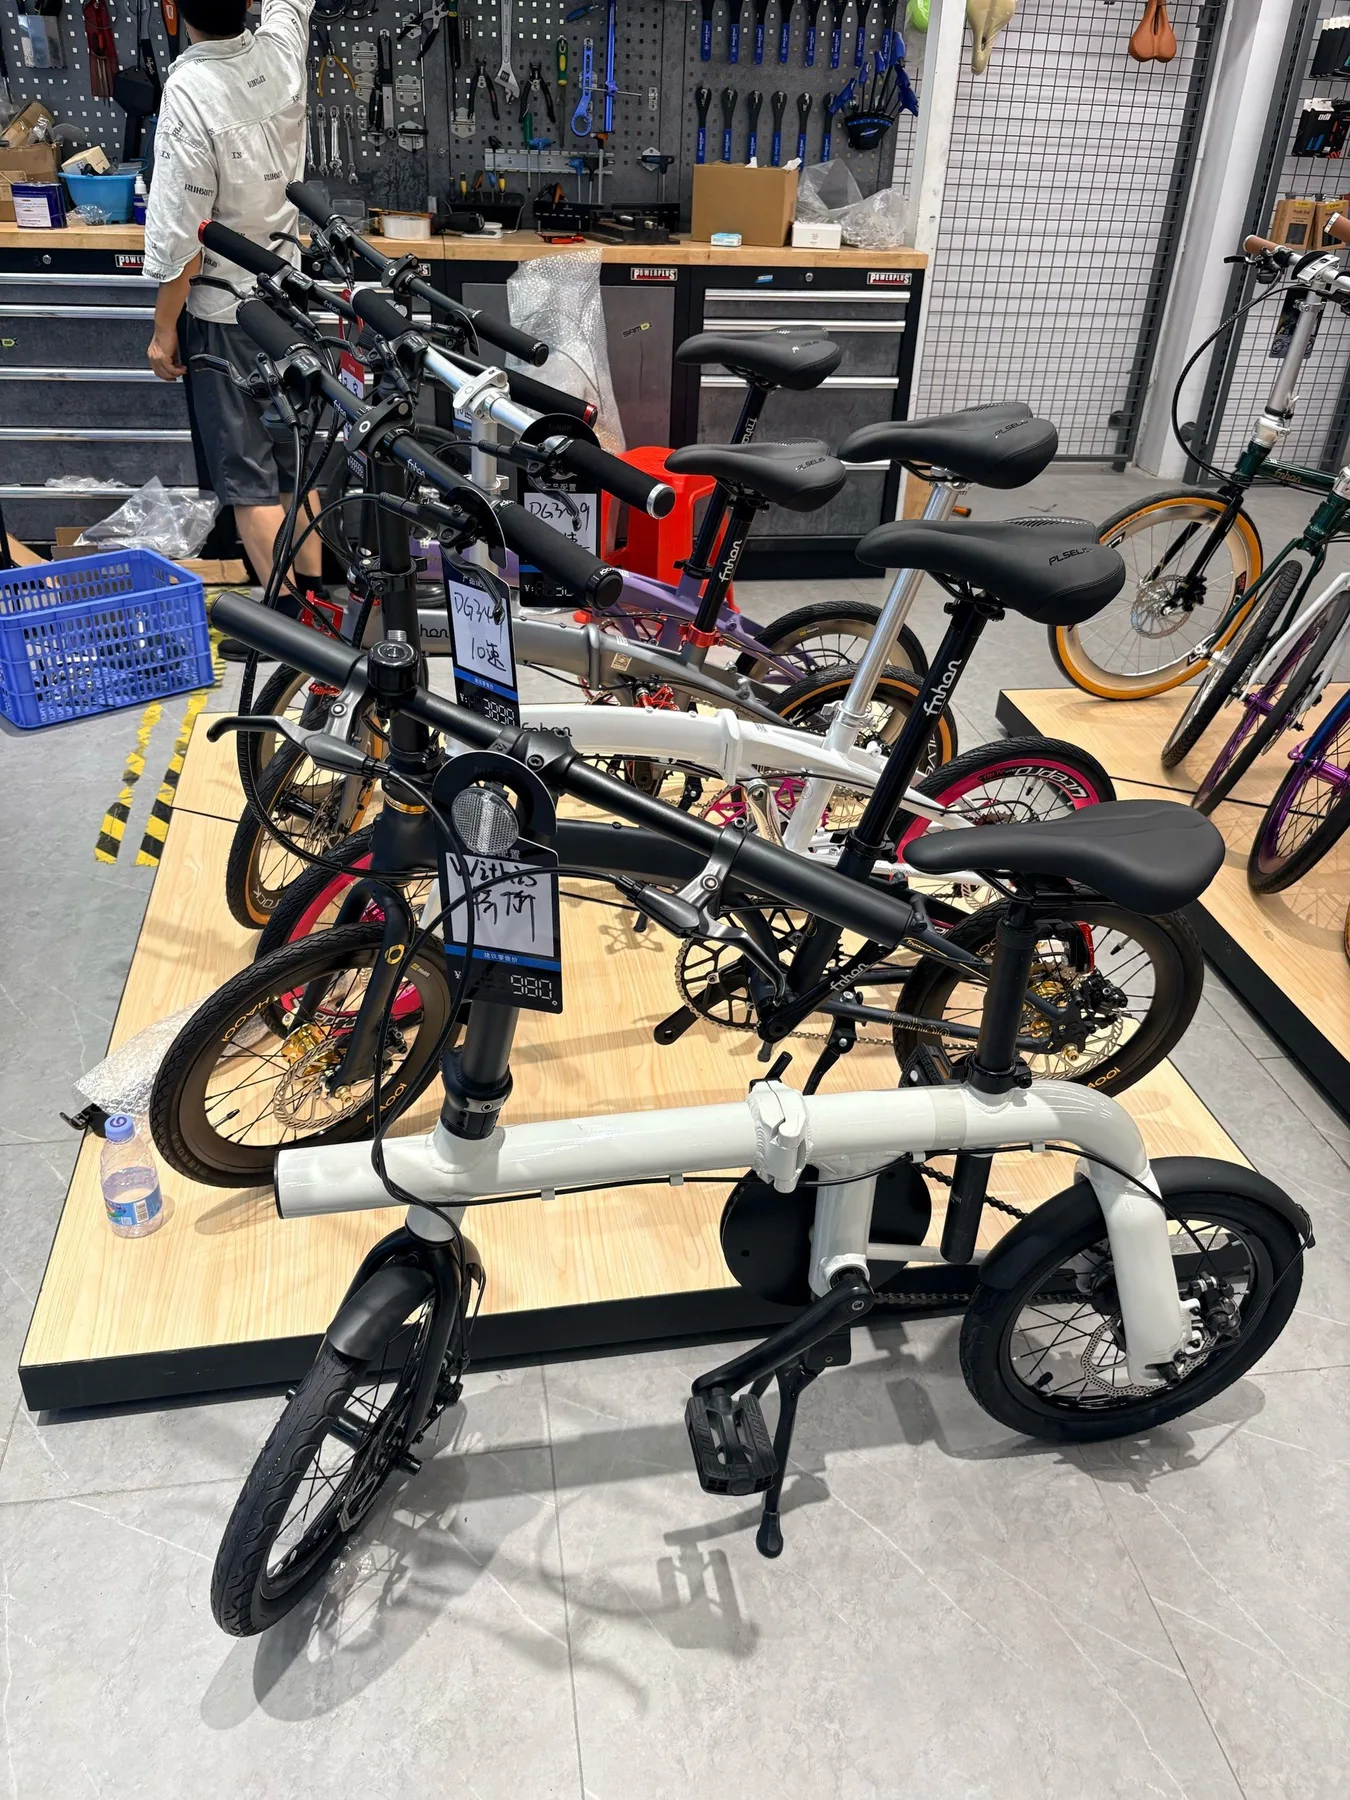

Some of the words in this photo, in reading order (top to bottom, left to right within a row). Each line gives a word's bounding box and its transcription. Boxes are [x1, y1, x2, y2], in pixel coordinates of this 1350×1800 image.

[634, 269, 676, 280] POWERPLUS
[870, 273, 910, 285] POWERPLUS
[484, 952, 518, 963] 建议零售价
